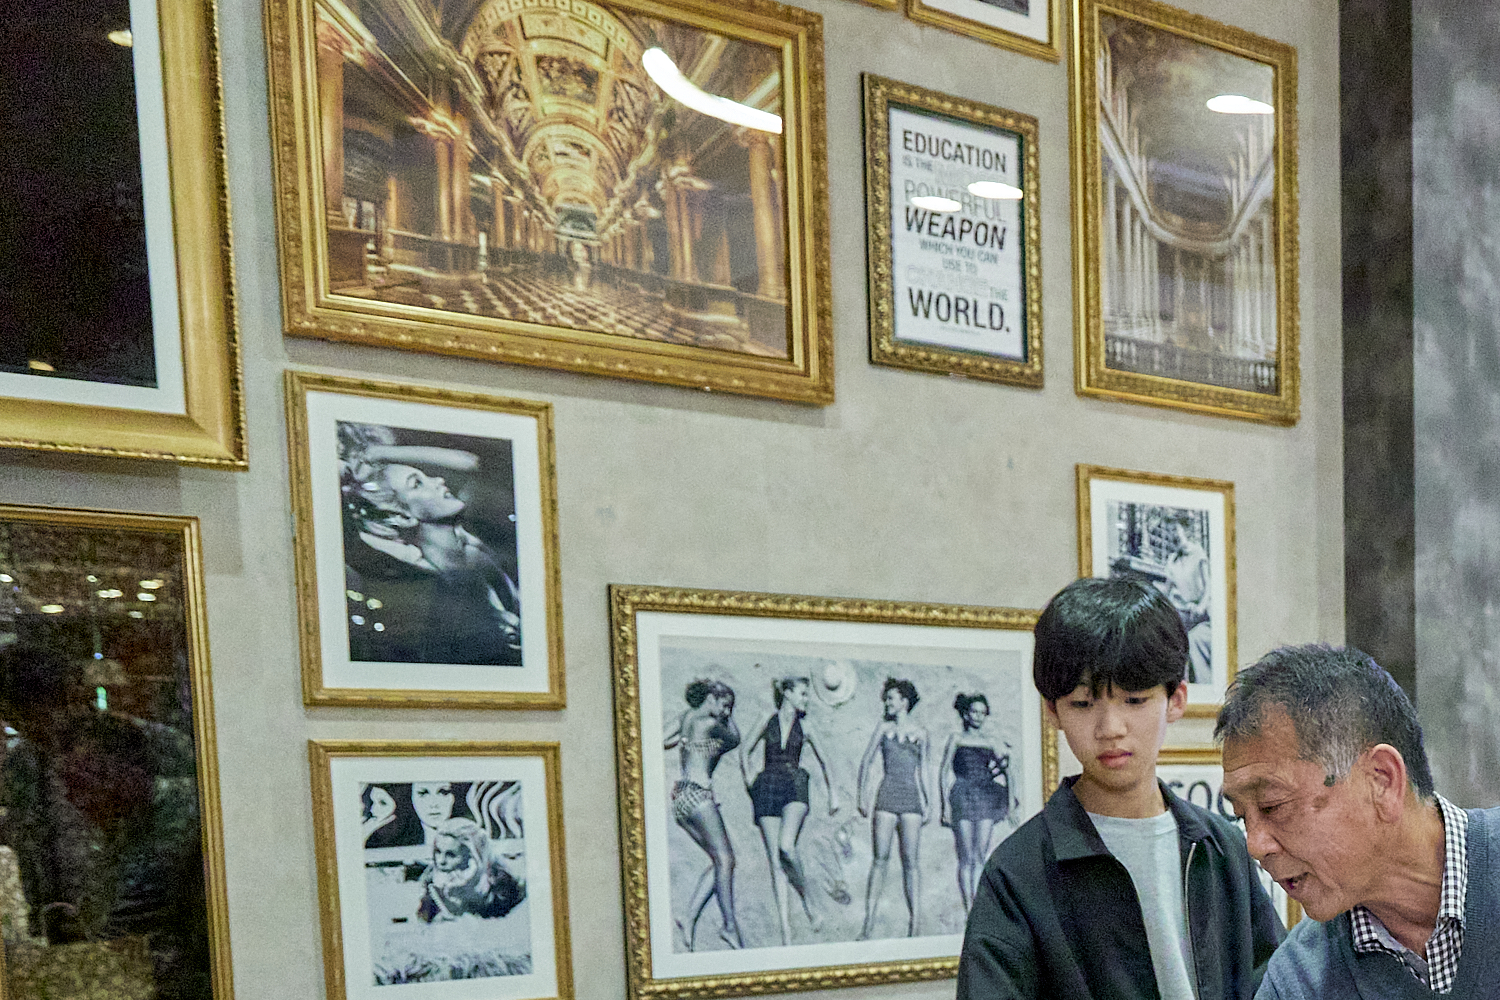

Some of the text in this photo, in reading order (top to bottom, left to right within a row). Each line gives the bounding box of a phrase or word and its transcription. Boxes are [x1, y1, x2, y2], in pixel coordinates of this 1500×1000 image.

[902, 129, 1006, 173] EDUCATION
[904, 207, 1007, 250] WEAPON
[920, 240, 953, 256] WHICH
[956, 246, 976, 261] YOU
[907, 286, 1010, 333] WORLD.
